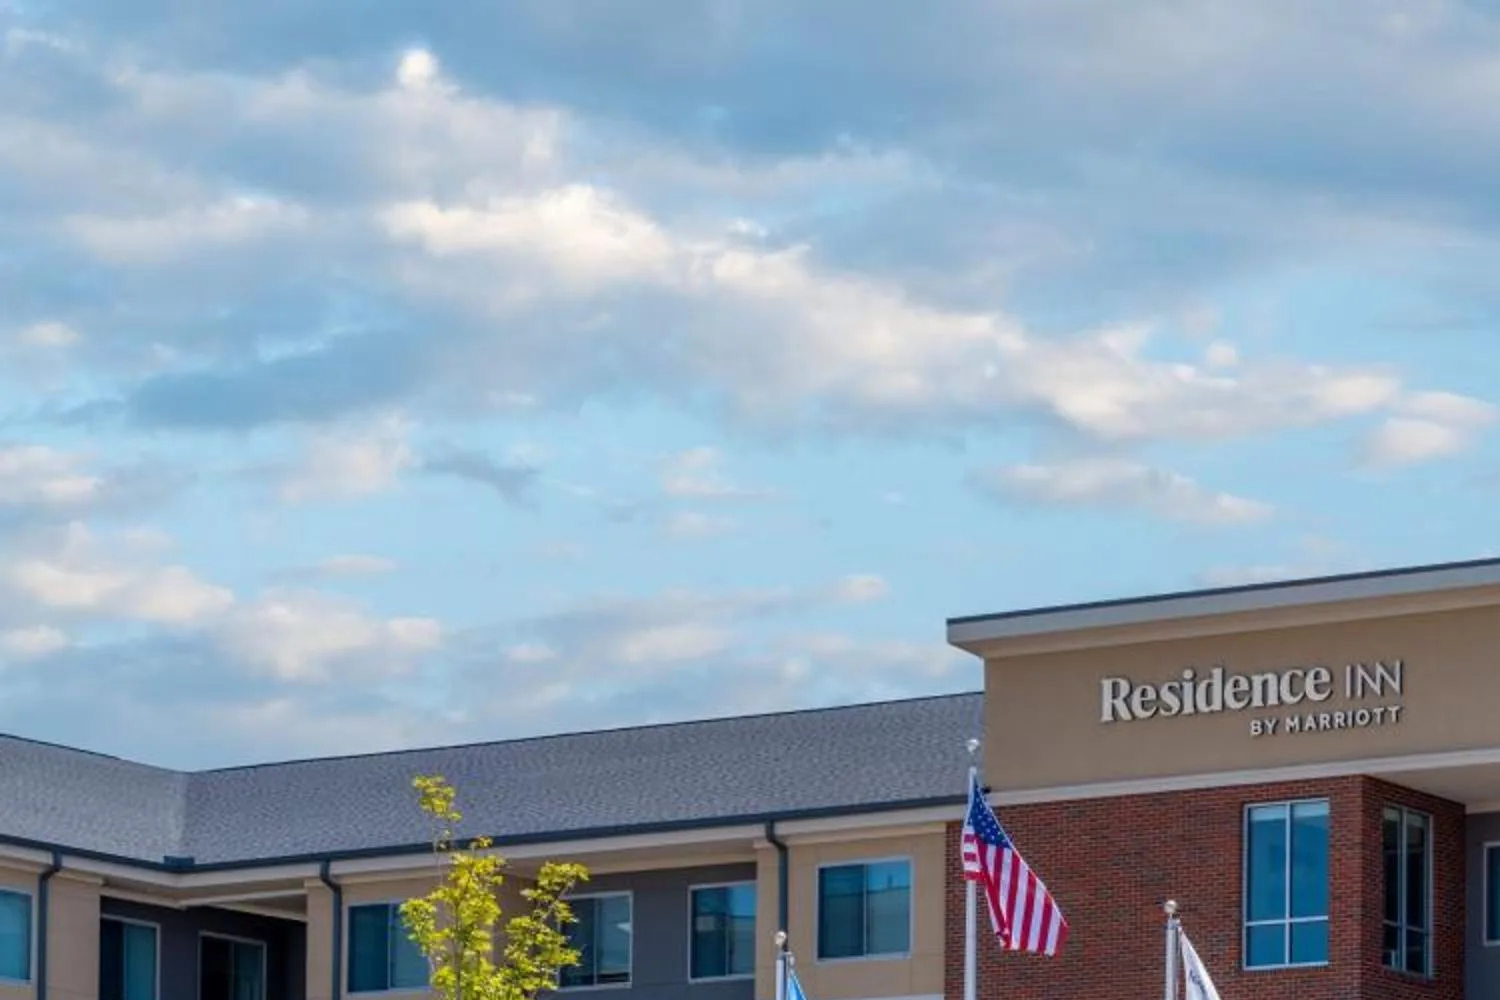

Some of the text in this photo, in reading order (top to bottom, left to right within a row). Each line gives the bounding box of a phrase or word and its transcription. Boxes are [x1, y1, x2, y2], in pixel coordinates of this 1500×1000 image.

[1099, 660, 1403, 722] Residence INN
[1250, 705, 1401, 737] BY MARRIOTT
